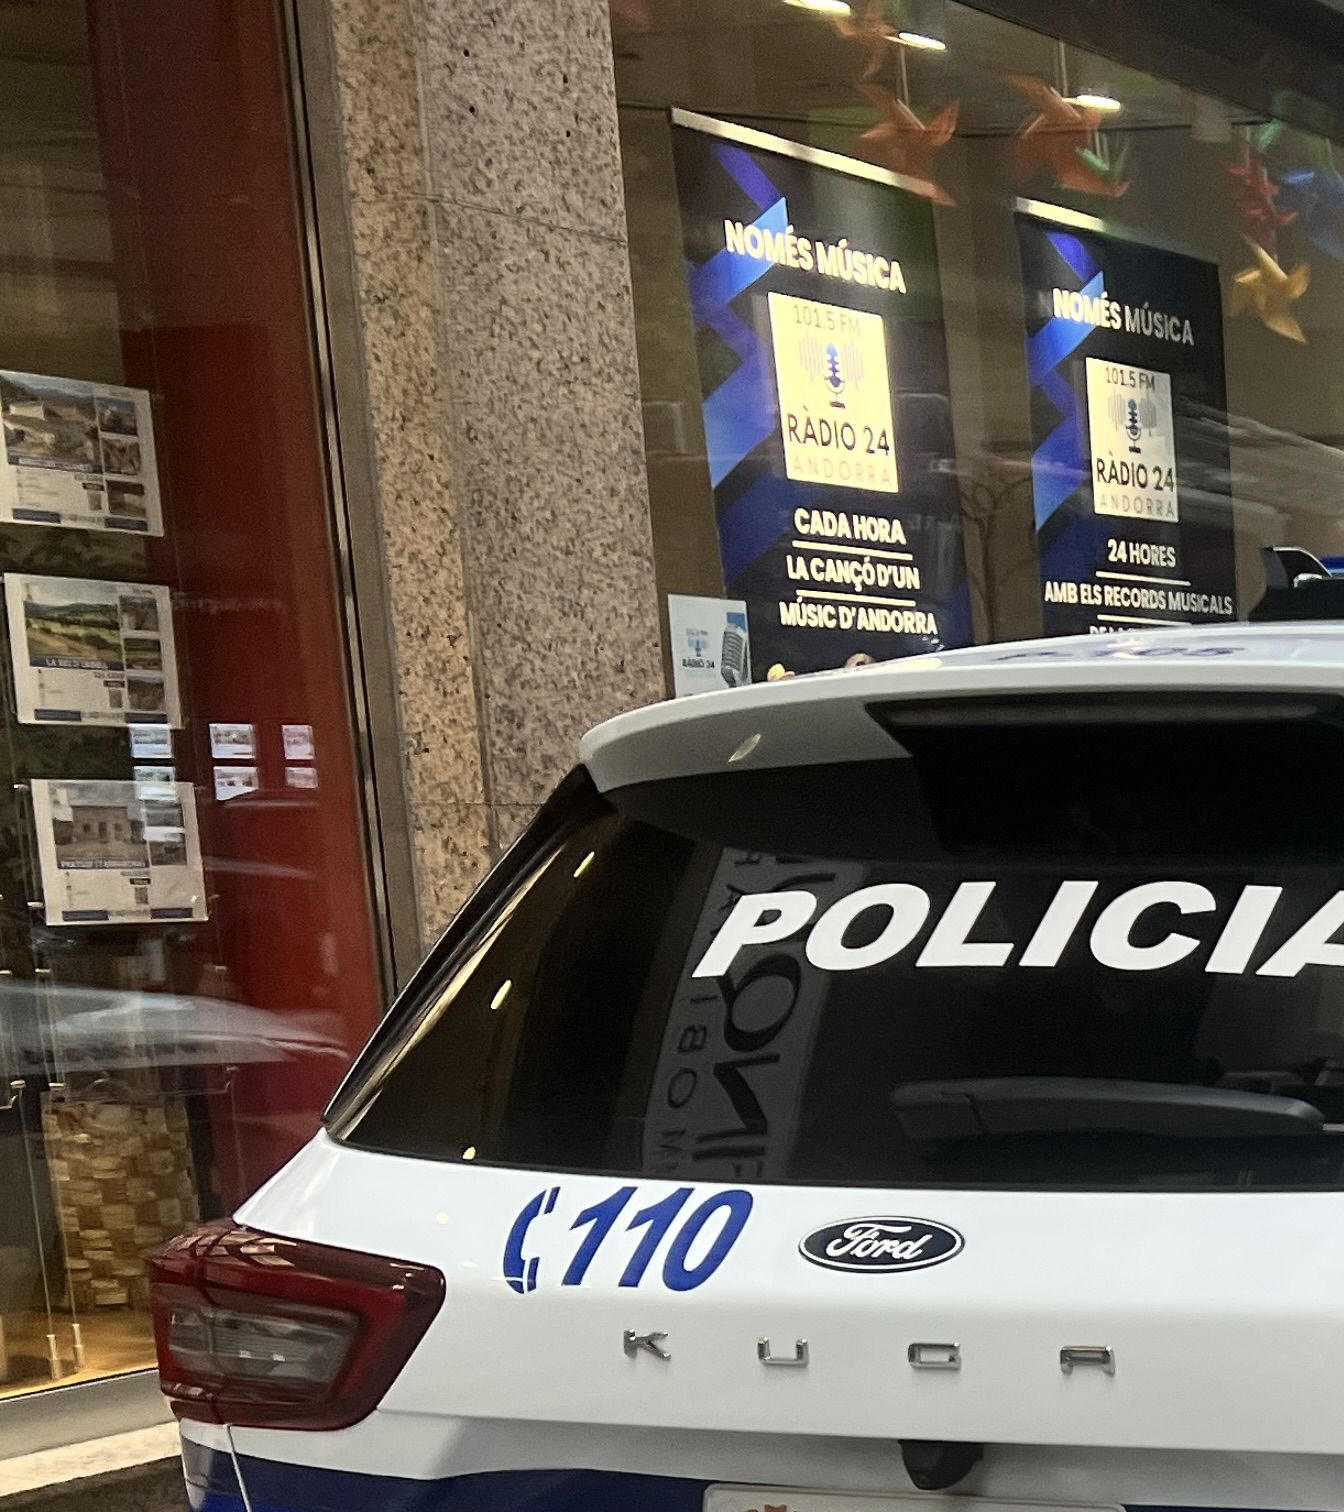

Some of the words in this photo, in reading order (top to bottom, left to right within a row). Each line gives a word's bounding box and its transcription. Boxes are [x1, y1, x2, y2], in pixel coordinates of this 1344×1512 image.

[724, 219, 814, 271] NOMÉS
[815, 238, 907, 294] MÚSICA
[793, 304, 835, 331] 101.5
[840, 314, 861, 336] FM
[1052, 287, 1122, 330] NOMÉS
[1124, 301, 1195, 346] MÚSICA
[1105, 366, 1137, 388] 101.5
[1138, 373, 1156, 393] FM
[787, 405, 856, 451] RÀDIO
[862, 424, 890, 456] 24
[792, 456, 893, 486] ANDORRA
[1096, 450, 1149, 489] RÀDIO
[1151, 465, 1175, 492] 24
[1099, 493, 1176, 519] ANDORRA
[794, 507, 852, 539] CADA
[852, 514, 907, 545] HORA
[1107, 538, 1128, 563] 24
[1128, 540, 1177, 568] HORES
[786, 554, 809, 581] LA
[810, 556, 876, 592] CANÇÓ
[876, 564, 921, 590] D'UN
[778, 596, 837, 629] MÚSIC
[838, 606, 938, 635] D'ANDORRA
[1044, 580, 1078, 604] AMB
[1079, 582, 1102, 606] ELS
[1103, 585, 1167, 610] RECORDS
[1168, 590, 1233, 616] MUSICALS
[560, 1184, 755, 1293] 110
[824, 1219, 932, 1263] Ford
[622, 1327, 1117, 1375] KUGA
